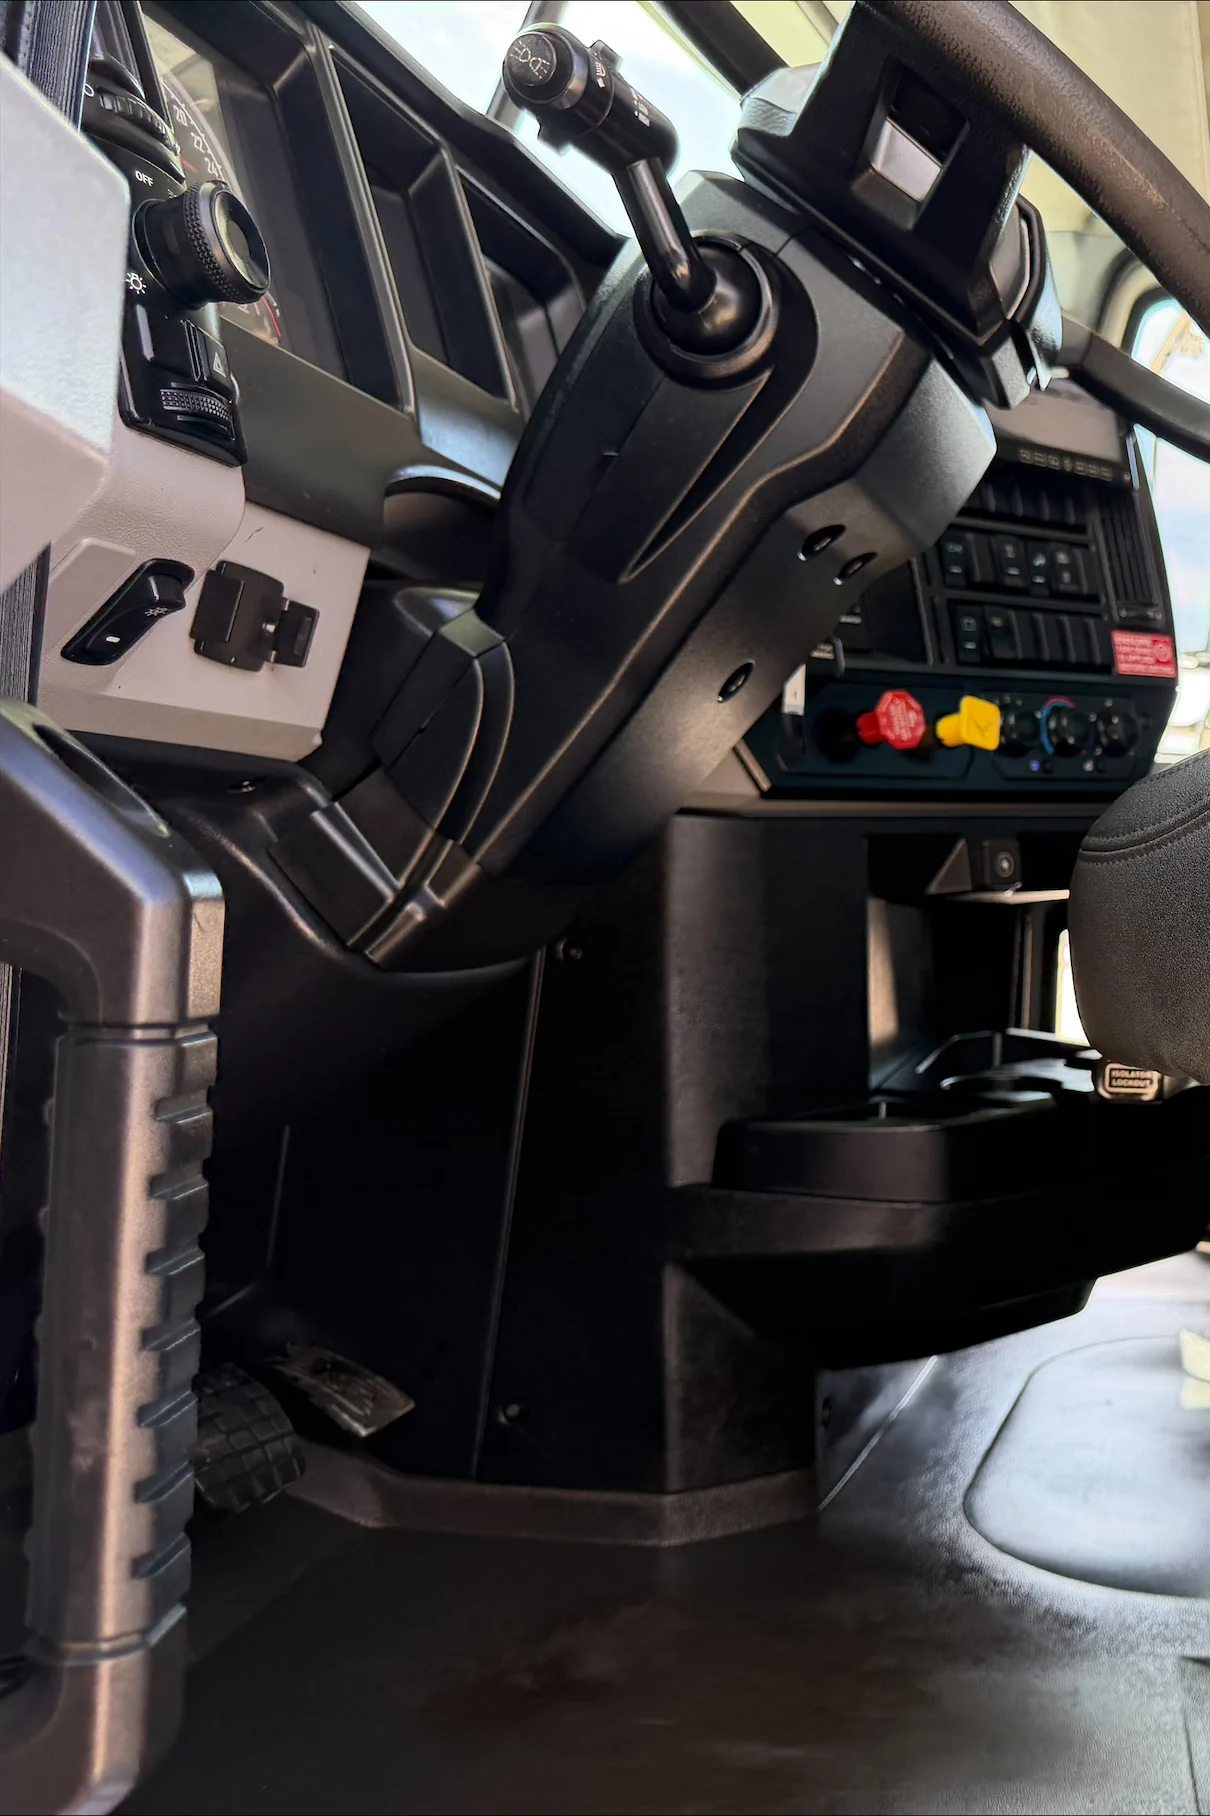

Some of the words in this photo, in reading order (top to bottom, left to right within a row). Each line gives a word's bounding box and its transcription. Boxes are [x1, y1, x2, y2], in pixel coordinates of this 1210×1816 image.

[173, 104, 188, 127] 20
[190, 132, 205, 153] 22
[204, 157, 218, 178] 24
[135, 171, 154, 187] OFF
